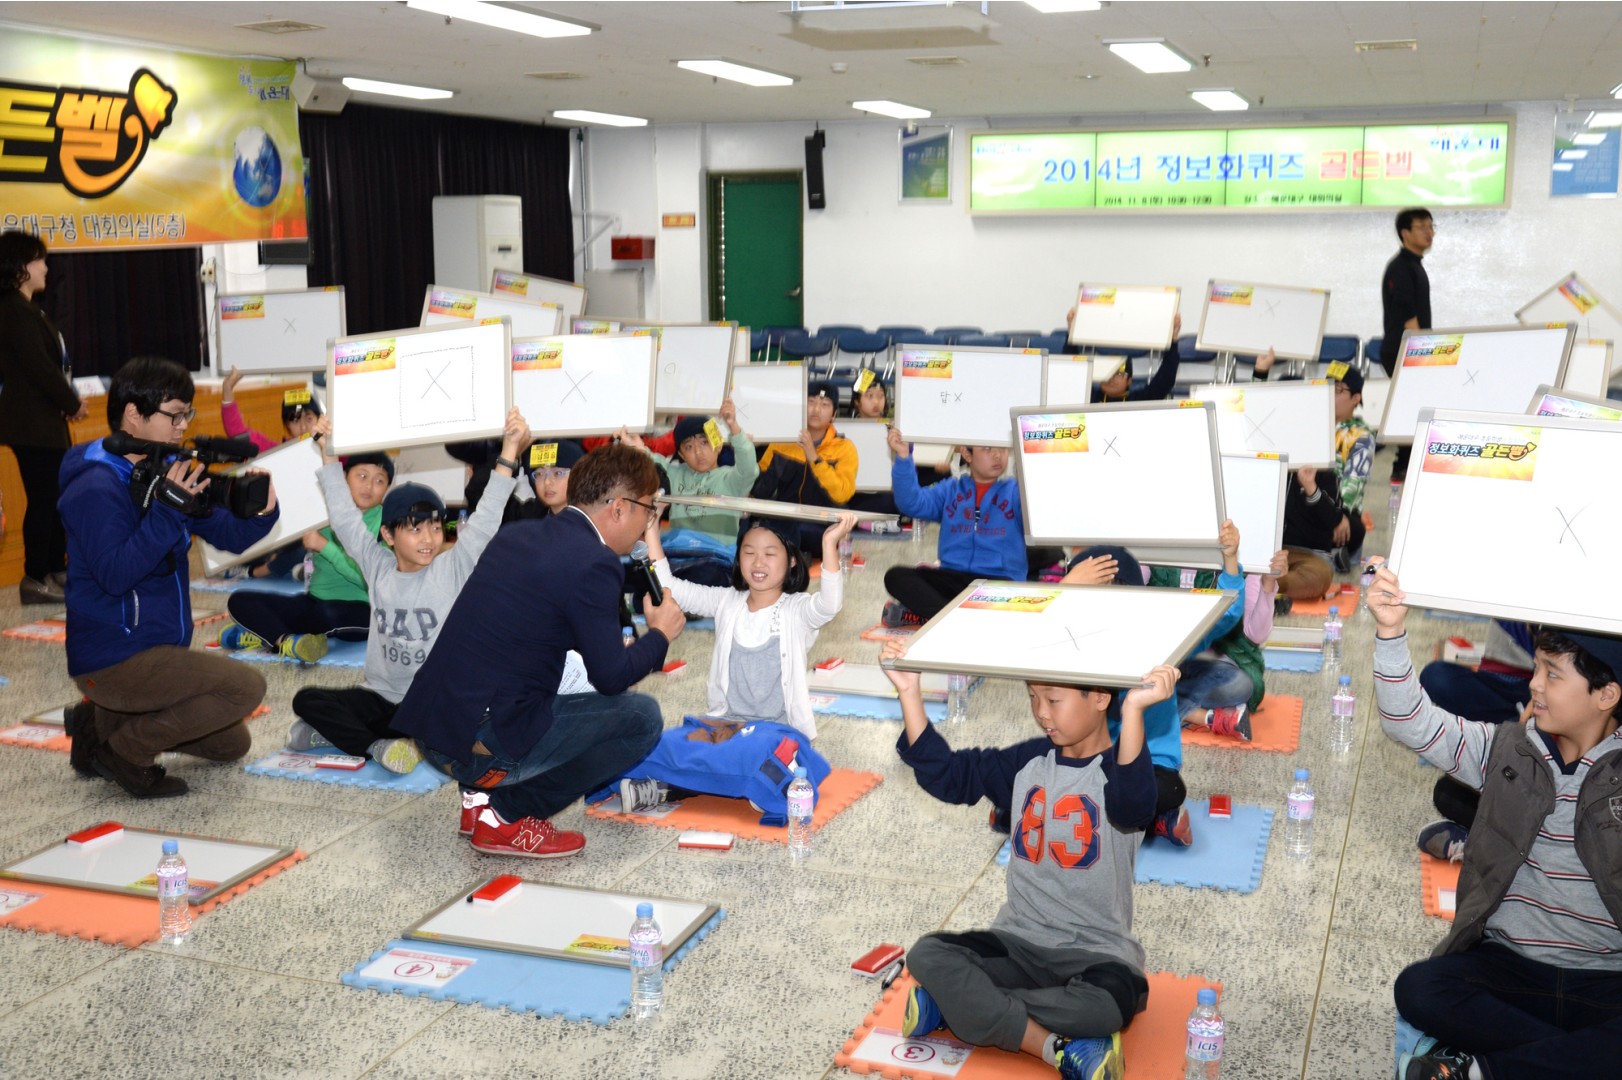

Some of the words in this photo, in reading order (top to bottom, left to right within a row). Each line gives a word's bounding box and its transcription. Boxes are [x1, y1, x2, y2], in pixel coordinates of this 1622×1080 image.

[1043, 154, 1142, 183] 2014년
[1156, 152, 1306, 183] 정보화퀴즈
[1319, 150, 1413, 180] 골든벨
[82, 211, 187, 241] 대회의실(5층)
[1428, 441, 1482, 458] 정보화퀴즈
[1479, 442, 1533, 462] 골든벨
[382, 644, 427, 667] 1969
[1011, 783, 1101, 871] 83
[1197, 1040, 1218, 1051] ICIS
